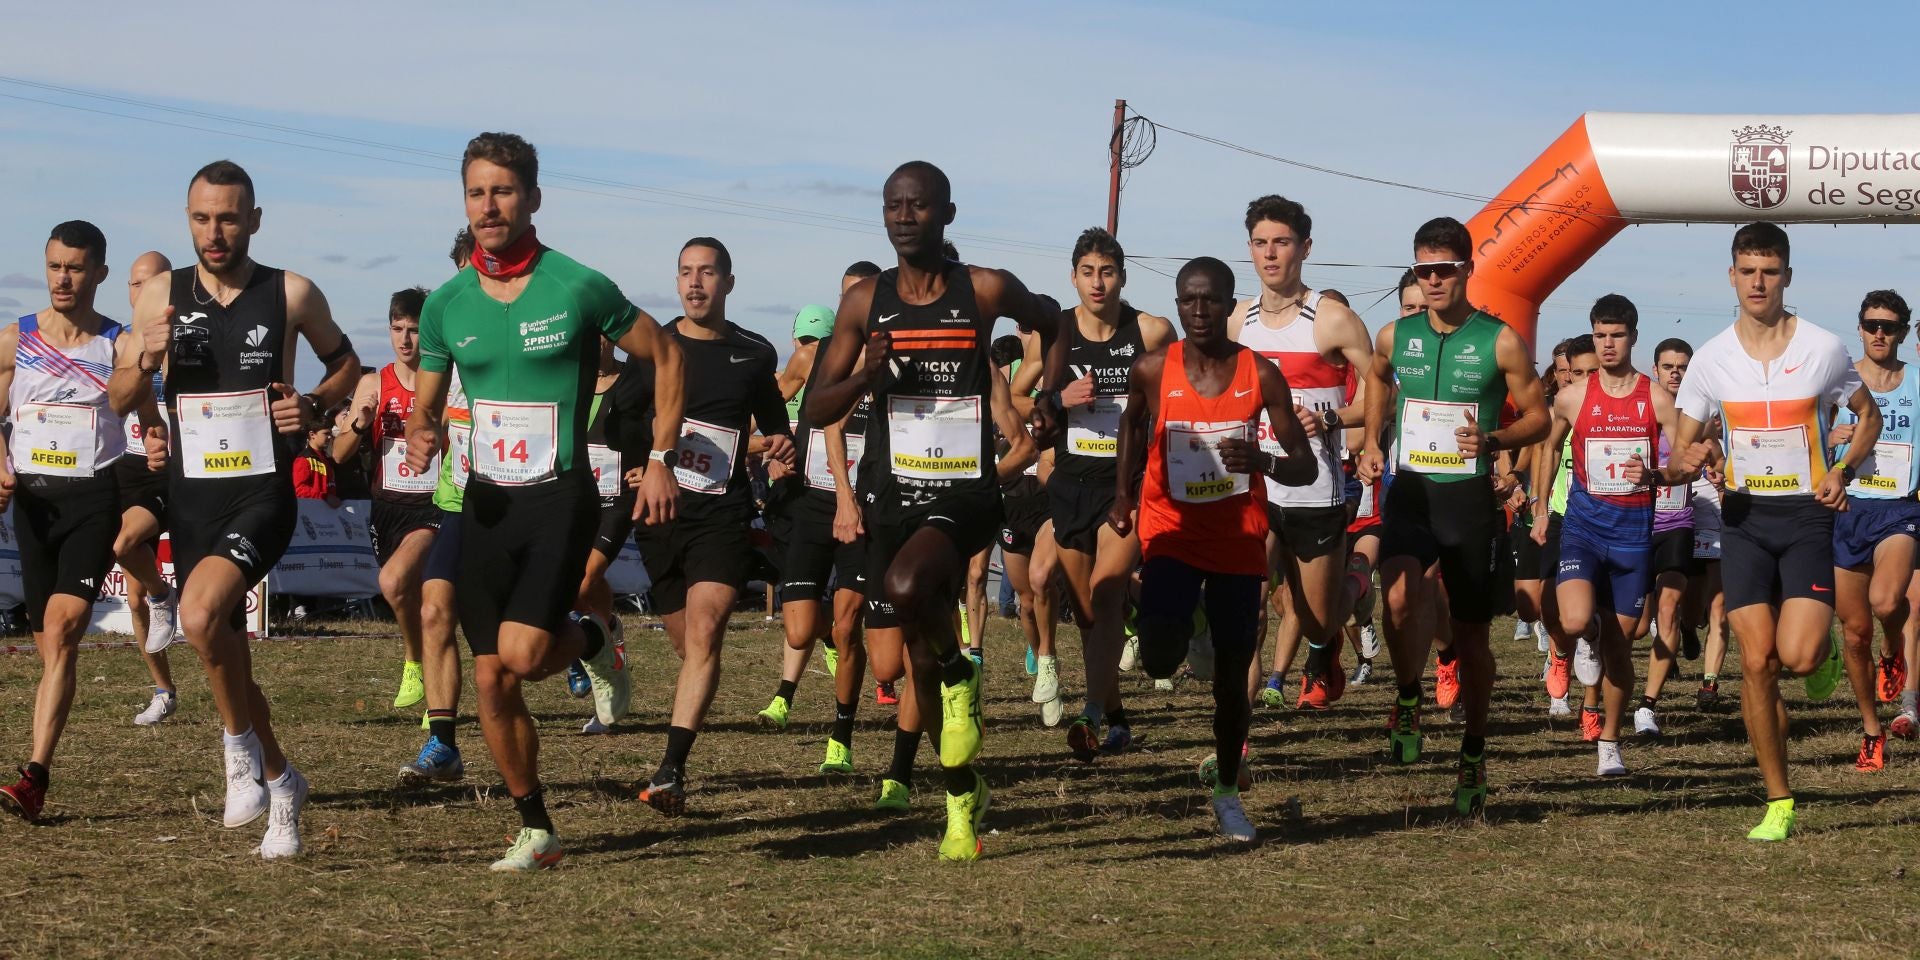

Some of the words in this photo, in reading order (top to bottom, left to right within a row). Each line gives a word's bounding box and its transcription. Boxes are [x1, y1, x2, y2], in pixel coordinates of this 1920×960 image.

[1807, 181, 1846, 206] de
[1496, 224, 1547, 270] NUESTROS
[1512, 241, 1549, 273] NUESTRA
[527, 310, 568, 328] universidad
[524, 331, 567, 346] SPRINT
[523, 344, 553, 352] ATLETISMO
[240, 350, 273, 359] Fundación
[239, 357, 264, 365] Unicaja
[914, 361, 961, 373] VICKY
[1094, 367, 1130, 377] VICKY
[918, 374, 956, 382] FOODS
[1605, 425, 1647, 433] MARATHON
[1098, 431, 1105, 439] 9
[50, 440, 58, 451] 3
[219, 439, 229, 450] 5
[1075, 441, 1085, 449] V.
[1429, 441, 1437, 452] 6
[492, 438, 529, 463] 14
[925, 447, 944, 458] 10
[31, 452, 77, 466] AFERDI
[204, 455, 252, 469] KNIYA
[679, 449, 713, 474] 85
[894, 456, 977, 470] NAZAMBIMANA
[1409, 453, 1466, 466] PANIAGUA
[1766, 465, 1774, 475] 2
[1874, 469, 1881, 477] 4
[1200, 471, 1215, 482] 11
[1185, 481, 1234, 496] KIPTOO
[1744, 478, 1799, 488] QUIJADA
[1859, 477, 1897, 489] GARCIA
[1560, 564, 1580, 573] ADM
